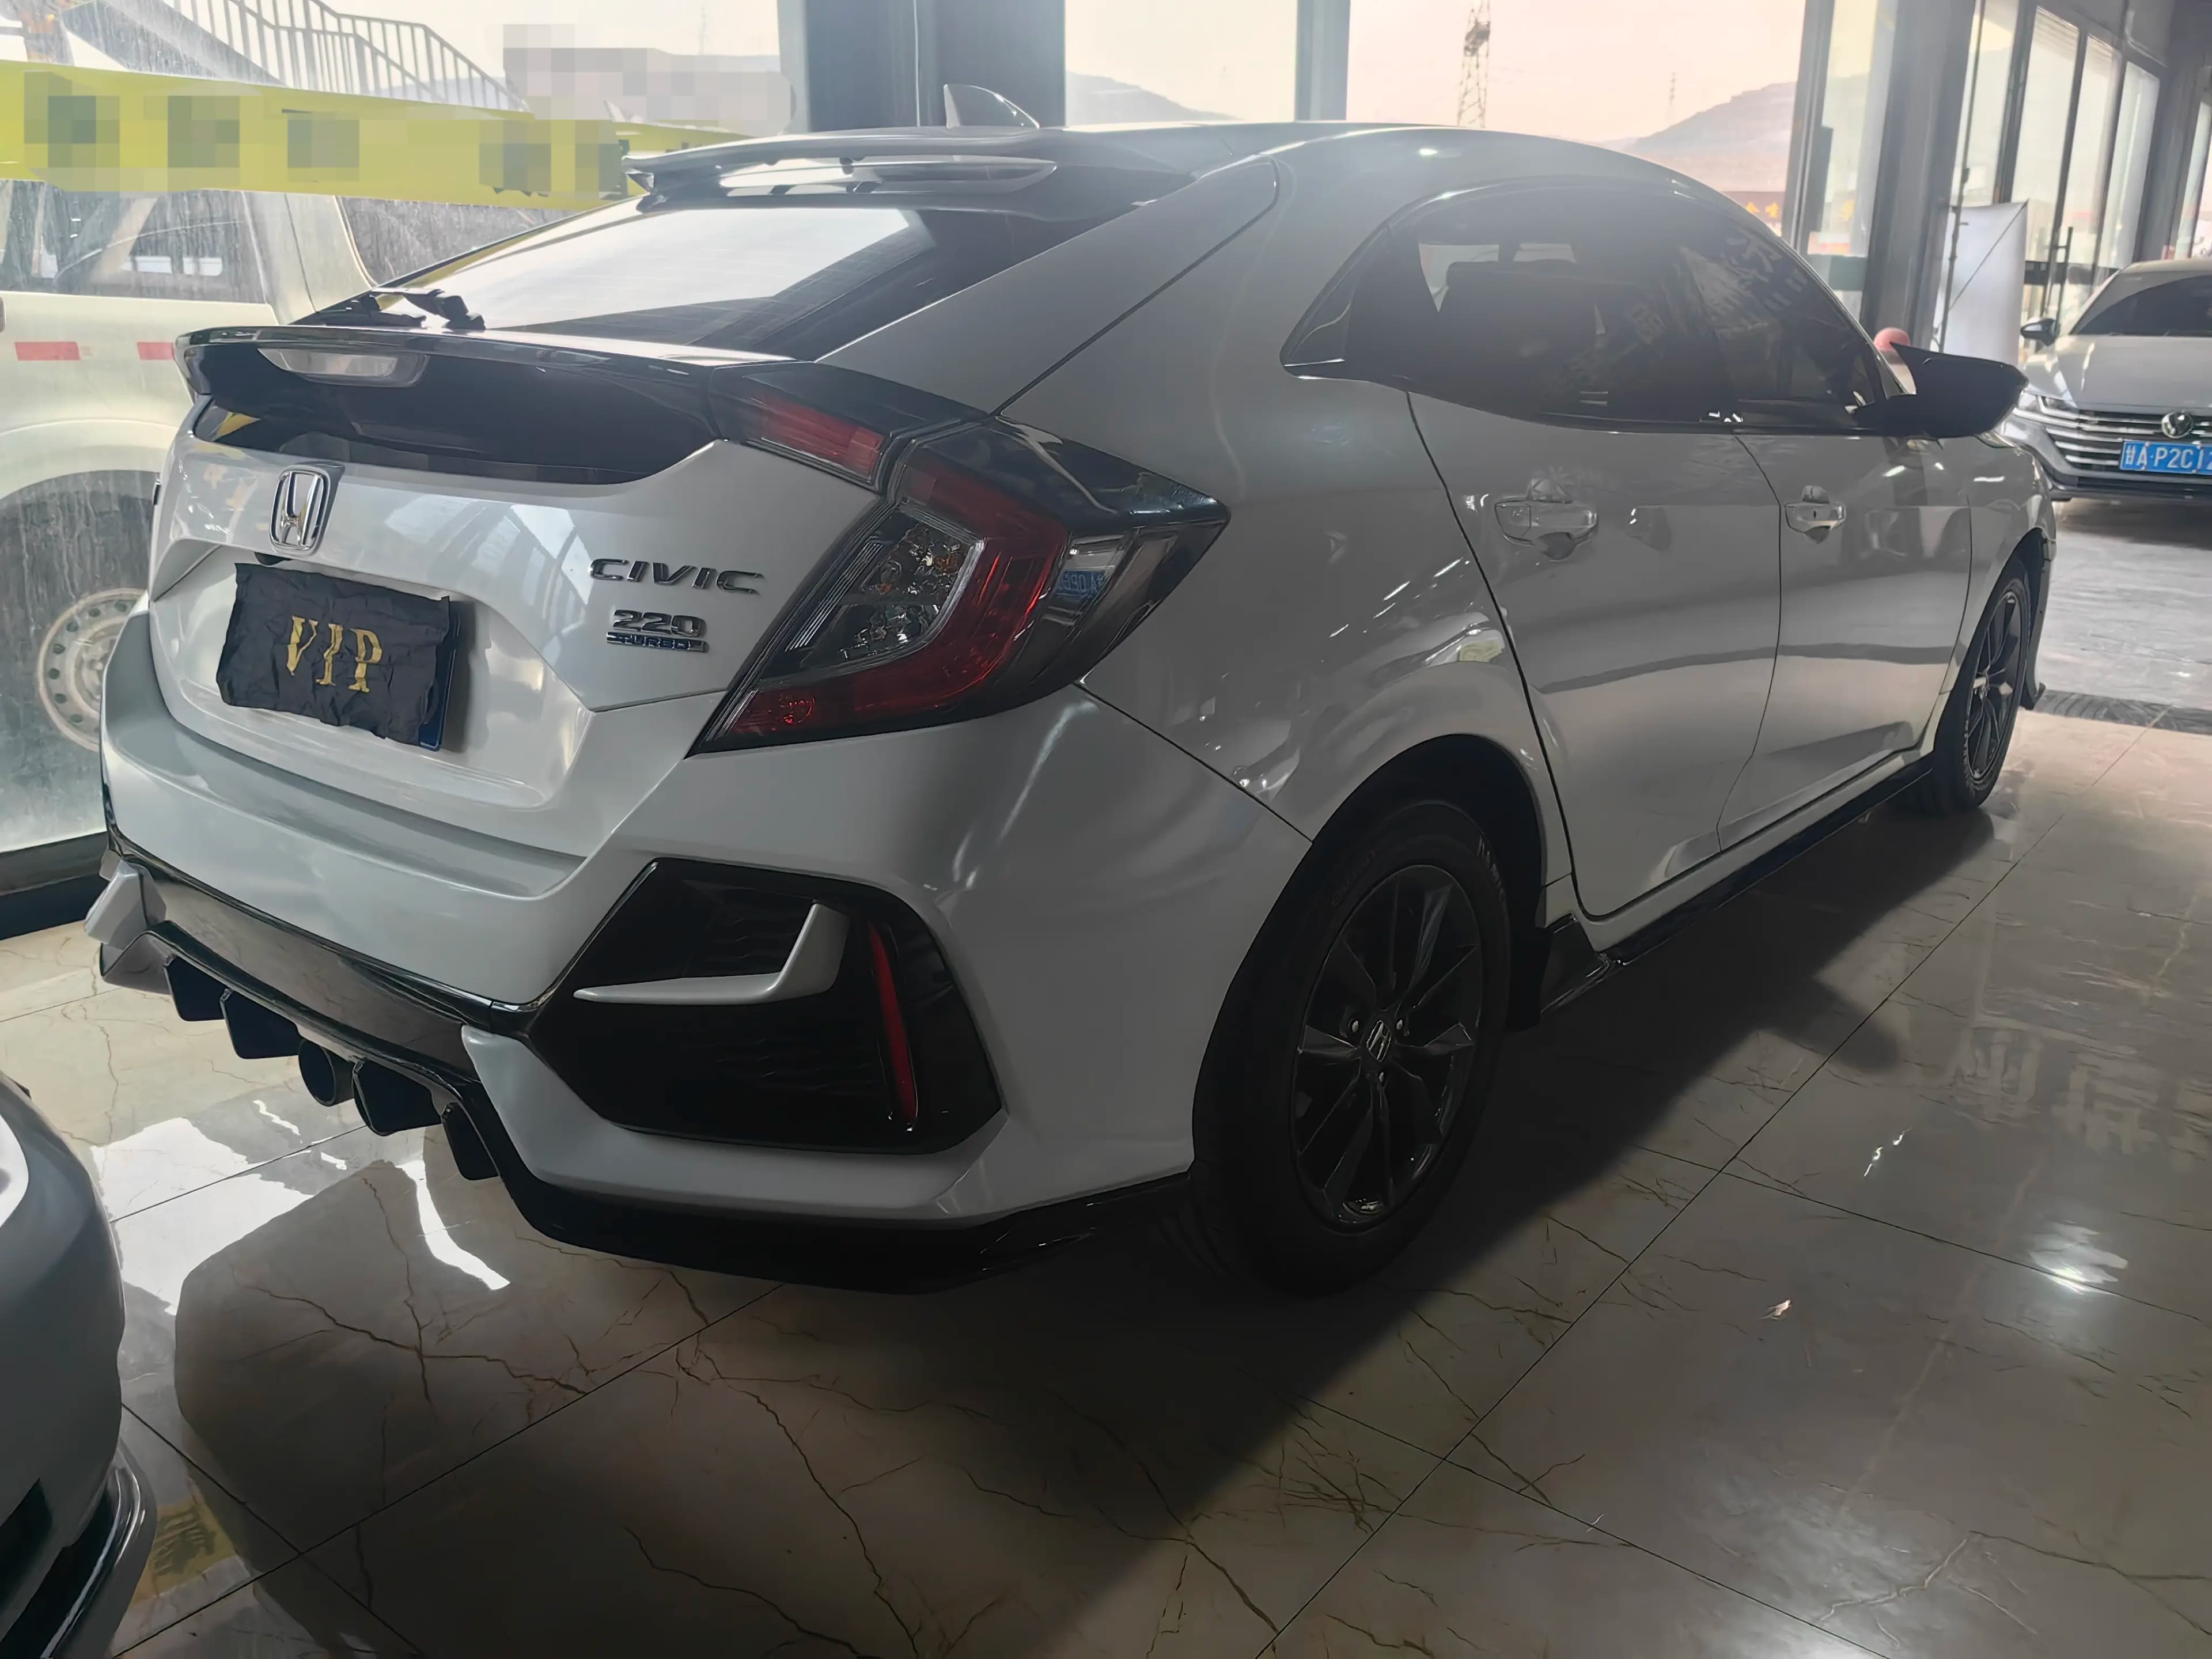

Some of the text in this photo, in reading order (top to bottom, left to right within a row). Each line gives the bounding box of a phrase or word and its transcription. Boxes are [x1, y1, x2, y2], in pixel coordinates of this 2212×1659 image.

[589, 558, 765, 594] CIVIC
[613, 609, 707, 637] 220
[287, 615, 382, 693] VIP
